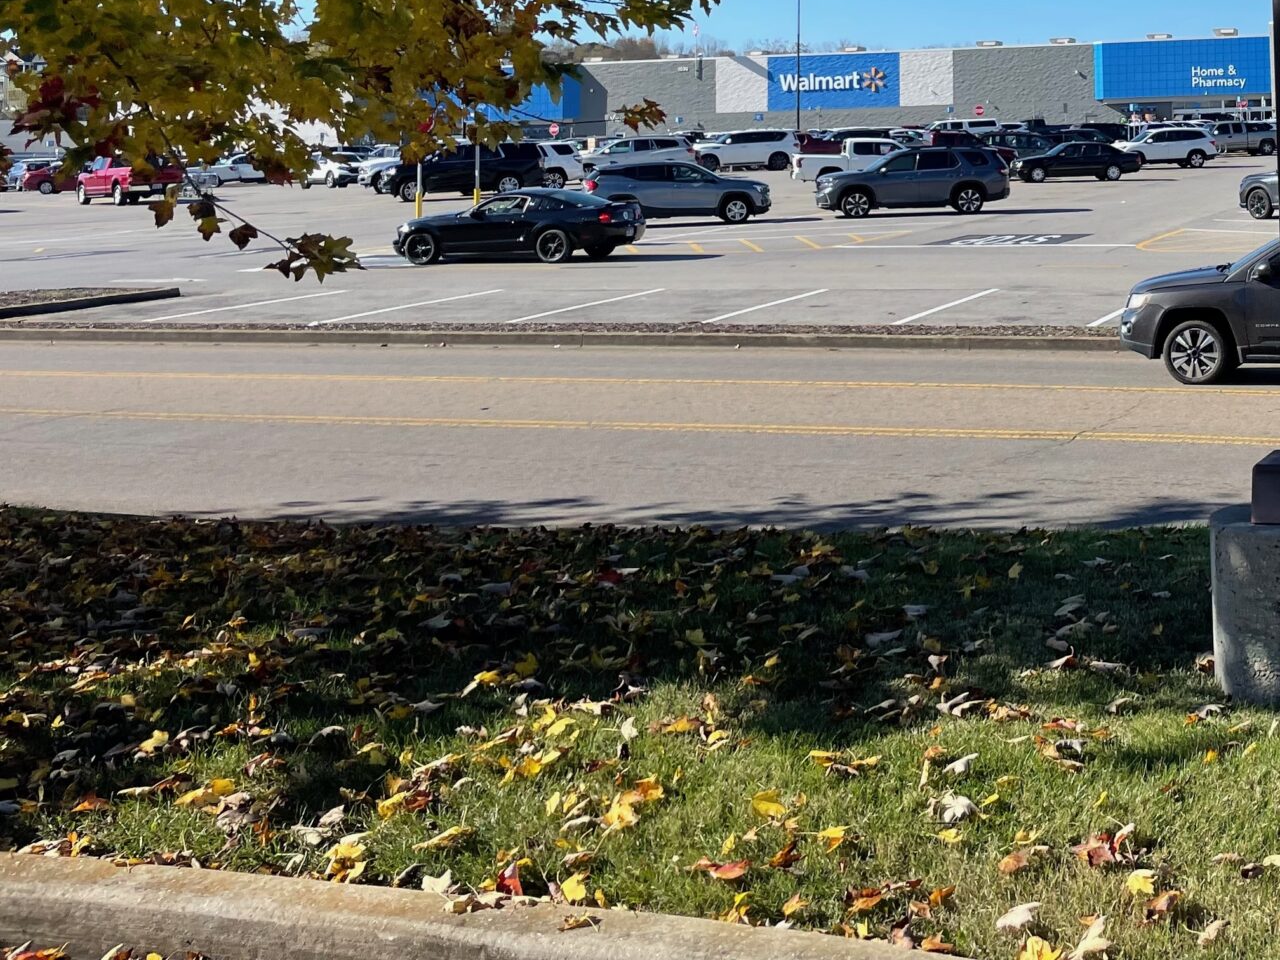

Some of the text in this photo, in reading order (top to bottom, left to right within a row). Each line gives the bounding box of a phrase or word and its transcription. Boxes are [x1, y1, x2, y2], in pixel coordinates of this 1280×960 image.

[1191, 64, 1236, 76] Home &
[779, 71, 860, 91] Walmart
[1191, 77, 1246, 88] Pharmacy
[950, 234, 1062, 245] STOP
